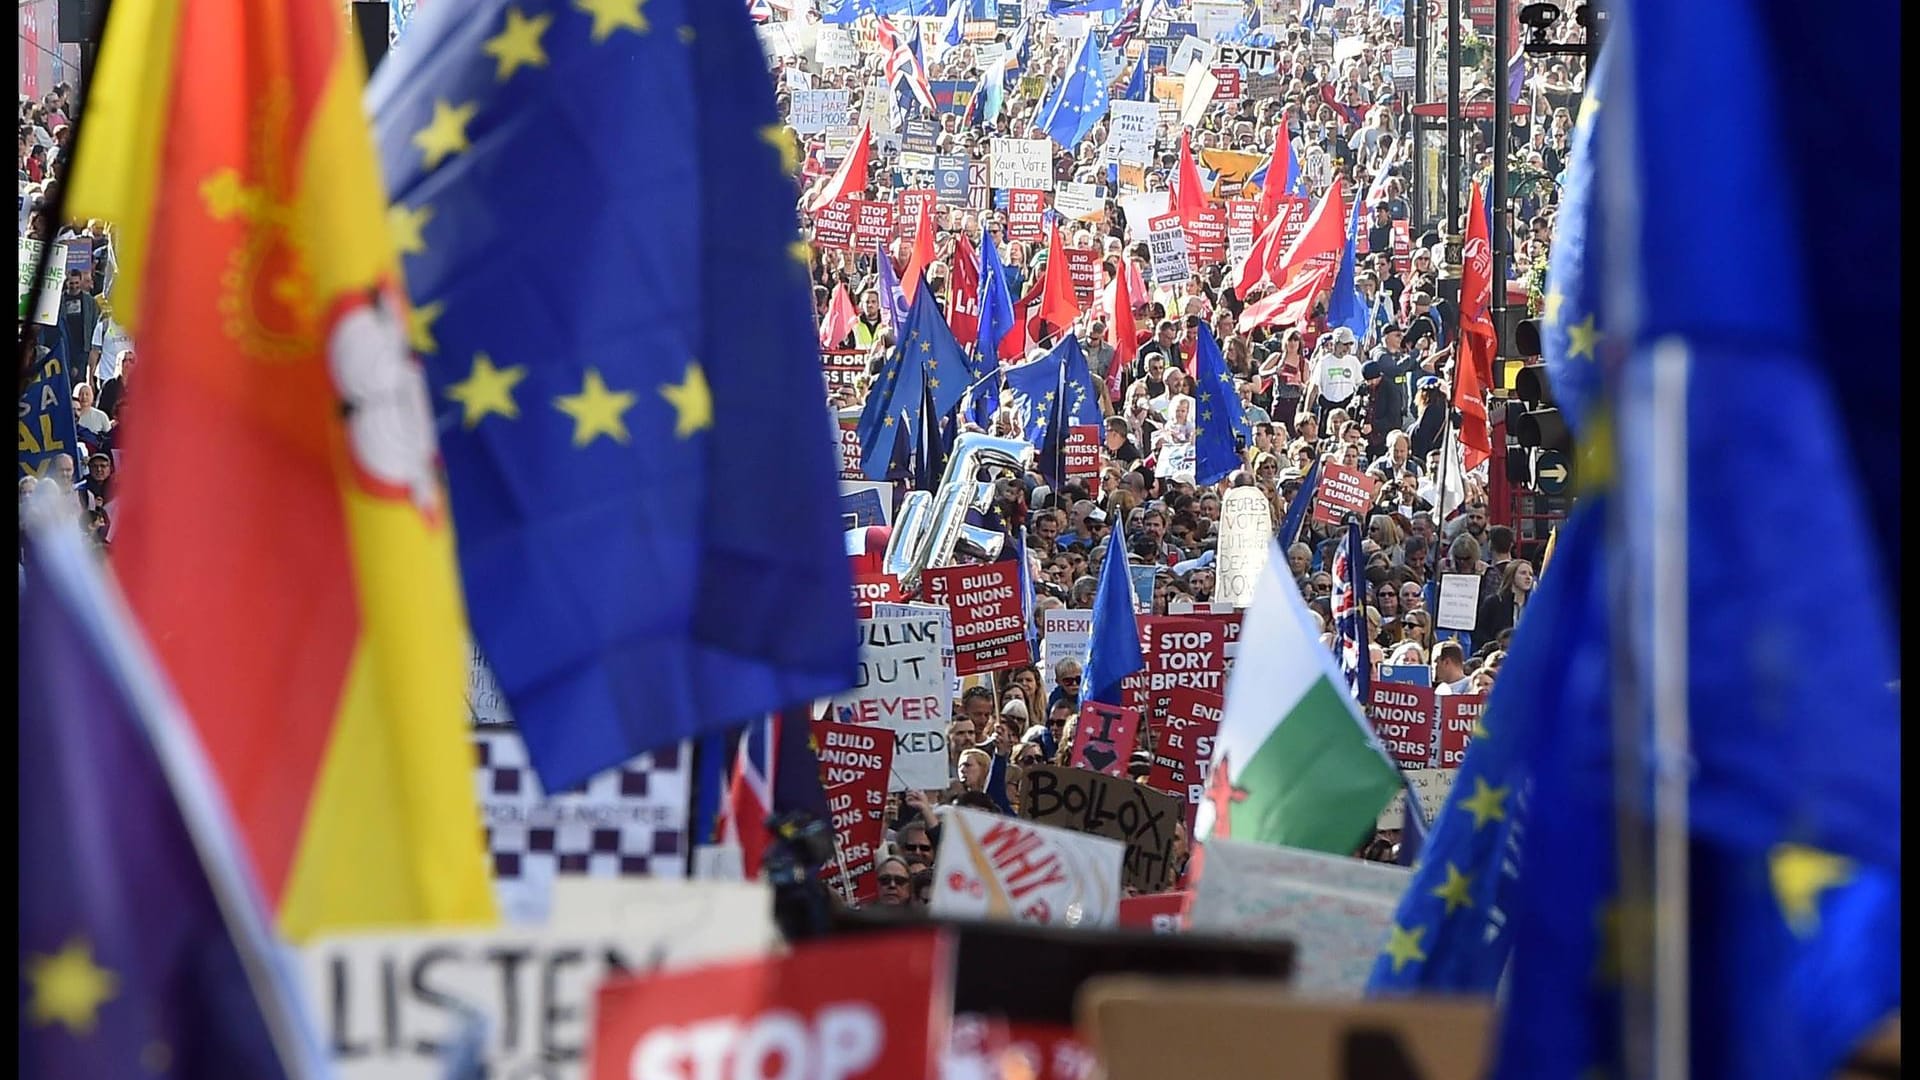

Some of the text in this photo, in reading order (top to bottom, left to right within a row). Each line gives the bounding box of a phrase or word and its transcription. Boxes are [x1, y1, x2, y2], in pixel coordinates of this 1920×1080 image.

[1219, 46, 1272, 70] EXIT
[793, 113, 818, 125] THE
[1014, 193, 1039, 202] STOP
[822, 209, 850, 222] TORY
[860, 205, 888, 216] STOP
[1013, 203, 1039, 212] TORY
[817, 218, 852, 233] BREXIT
[860, 216, 887, 227] TORY
[1009, 212, 1043, 223] BREXIT
[1154, 216, 1181, 231] STOP
[856, 225, 891, 237] BREXIT
[18, 240, 64, 257] BRET
[1151, 241, 1175, 254] REBEL
[1072, 254, 1089, 263] END
[1338, 472, 1360, 486] END
[1322, 478, 1370, 500] FORTRESS
[1325, 488, 1364, 508] EUROPE
[961, 571, 1004, 590] BUILD
[955, 585, 1014, 607] UNIONS
[970, 602, 1002, 620] NOT
[954, 616, 1021, 638] BORDERS
[1046, 619, 1090, 633] BREXI
[956, 632, 1023, 654] FREE MOVEMENT
[1160, 632, 1213, 650] STOP
[975, 647, 1008, 661] FOR ALL
[1158, 652, 1214, 671] TORY
[1151, 671, 1222, 692] BREXIT
[1374, 690, 1419, 707] BUILD
[1191, 703, 1224, 723] END
[826, 731, 875, 750] BUILD
[1156, 757, 1177, 769] FREE
[1027, 770, 1166, 852] BOLLOX
[330, 943, 669, 1063] LISTE
[630, 1003, 884, 1080] STOP
